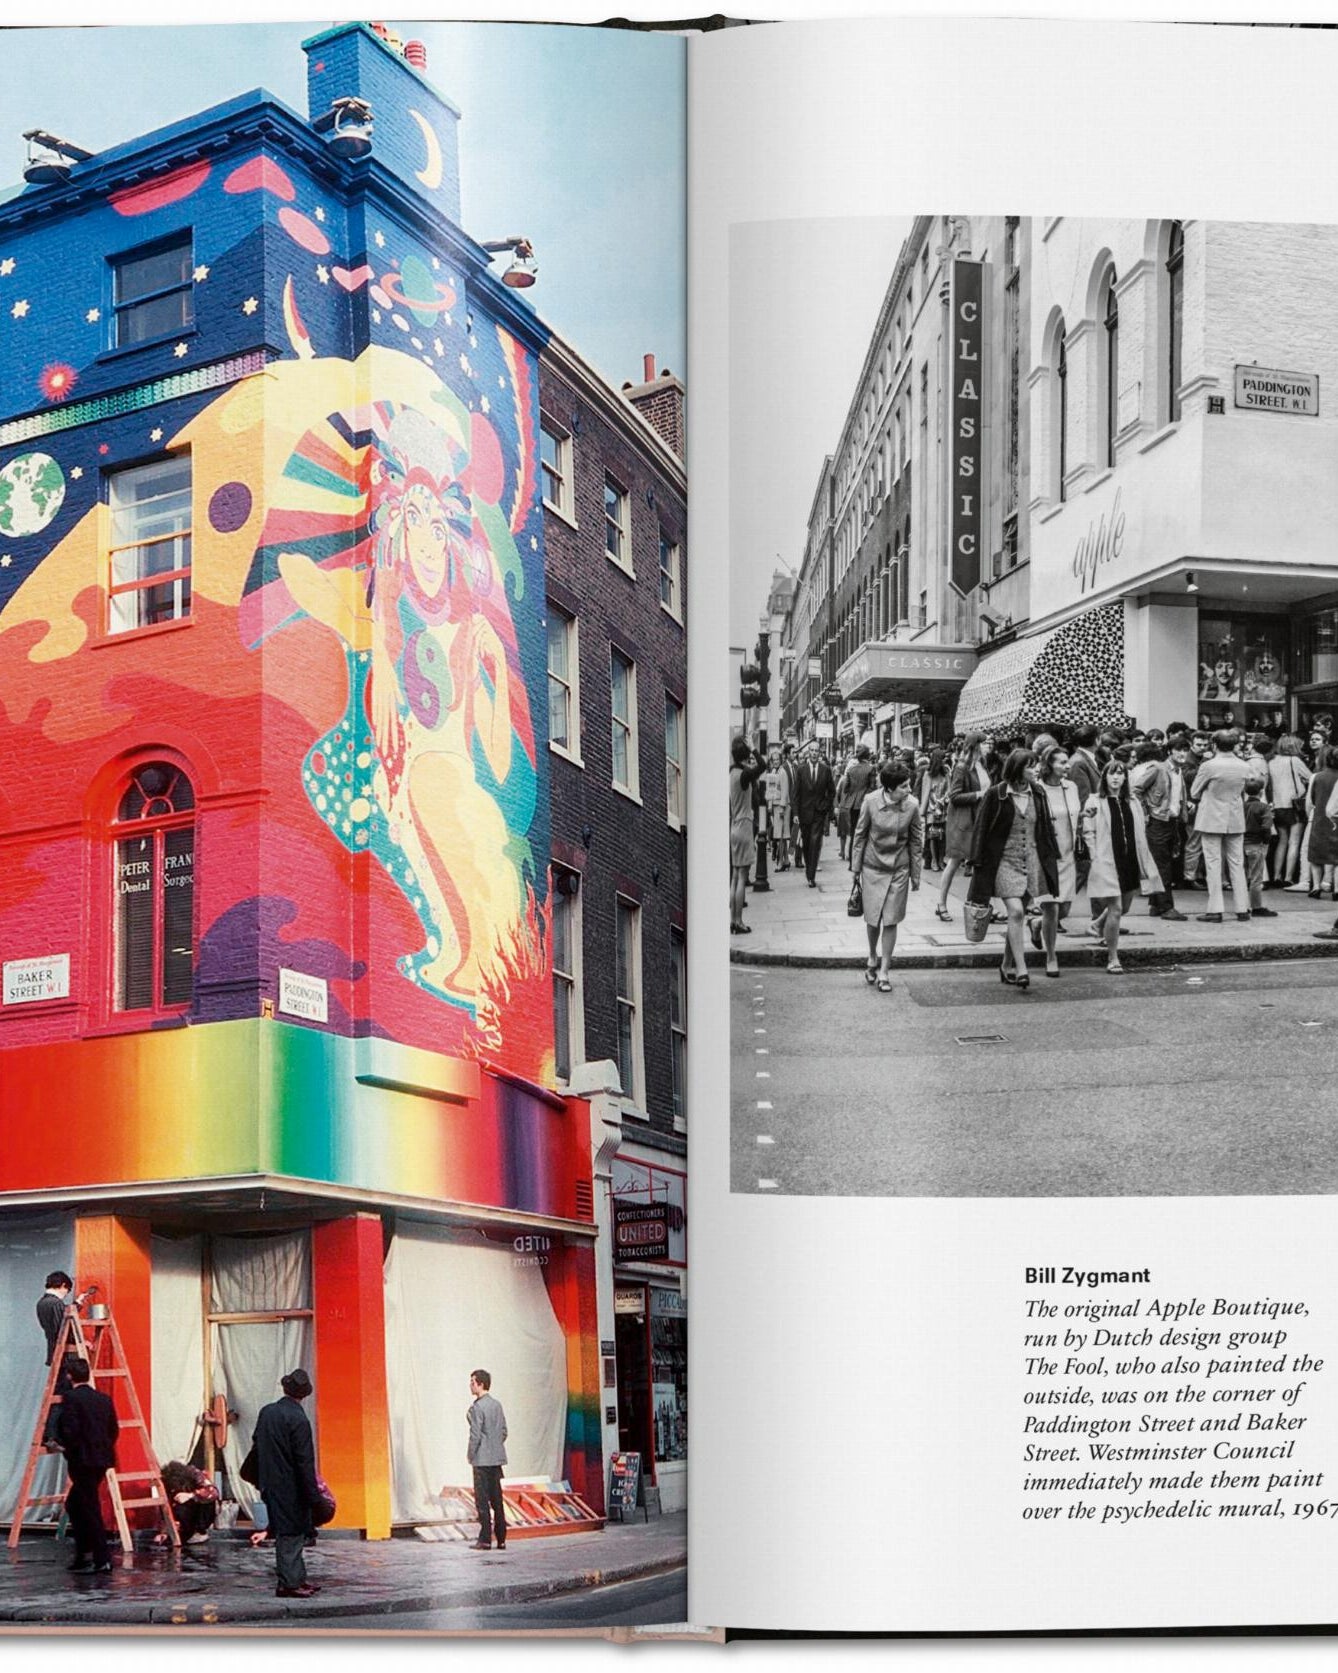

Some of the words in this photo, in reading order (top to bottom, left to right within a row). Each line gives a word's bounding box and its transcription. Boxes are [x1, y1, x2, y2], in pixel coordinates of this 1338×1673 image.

[1242, 379, 1311, 397] PADDINGTON
[957, 301, 978, 555] CLASSIC
[1073, 485, 1126, 594] apple
[888, 657, 964, 669] CLASSIC
[120, 861, 150, 877] PETER
[120, 879, 150, 894] Dental
[17, 969, 53, 985] BAKER
[9, 984, 44, 999] STREET
[286, 997, 310, 1015] STREET
[616, 1208, 666, 1222] CONFECTIONERS
[619, 1223, 665, 1242] UNITED
[617, 1245, 666, 1257] TOBACCONISTS
[1025, 1267, 1056, 1284] Bill
[1061, 1266, 1151, 1289] Zygmant
[1025, 1299, 1059, 1318] The
[1064, 1298, 1141, 1323] original
[1145, 1297, 1206, 1322] Apple
[1212, 1297, 1309, 1320] Boutique,
[1024, 1334, 1057, 1347] run
[1063, 1328, 1088, 1352] by
[1092, 1327, 1153, 1347] Dutch
[1159, 1327, 1221, 1351] design
[1226, 1329, 1288, 1350] group
[1025, 1356, 1058, 1376] The
[1063, 1356, 1109, 1377] Fool,
[1115, 1355, 1156, 1375] who
[1160, 1355, 1201, 1374] also
[1205, 1354, 1288, 1379] painted
[1292, 1353, 1324, 1372] the
[1023, 1385, 1094, 1405] outside,
[1101, 1391, 1138, 1404] was
[1143, 1390, 1169, 1403] on
[1175, 1384, 1206, 1403] the
[1212, 1389, 1276, 1403] corner
[1282, 1381, 1307, 1407] of
[1023, 1414, 1131, 1439] Paddington
[1138, 1414, 1195, 1433] Street
[1199, 1412, 1242, 1432] and
[1246, 1412, 1308, 1431] Baker
[1023, 1444, 1080, 1462] Street.
[1088, 1442, 1207, 1461] Westminster
[1213, 1440, 1296, 1460] Council
[1023, 1471, 1143, 1495] immediately
[1148, 1470, 1204, 1489] made
[1210, 1470, 1260, 1489] them
[1265, 1469, 1324, 1493] paint
[1022, 1507, 1063, 1520] over
[1067, 1501, 1097, 1520] the
[1100, 1499, 1213, 1524] psychedelic
[1218, 1498, 1285, 1517] mural,
